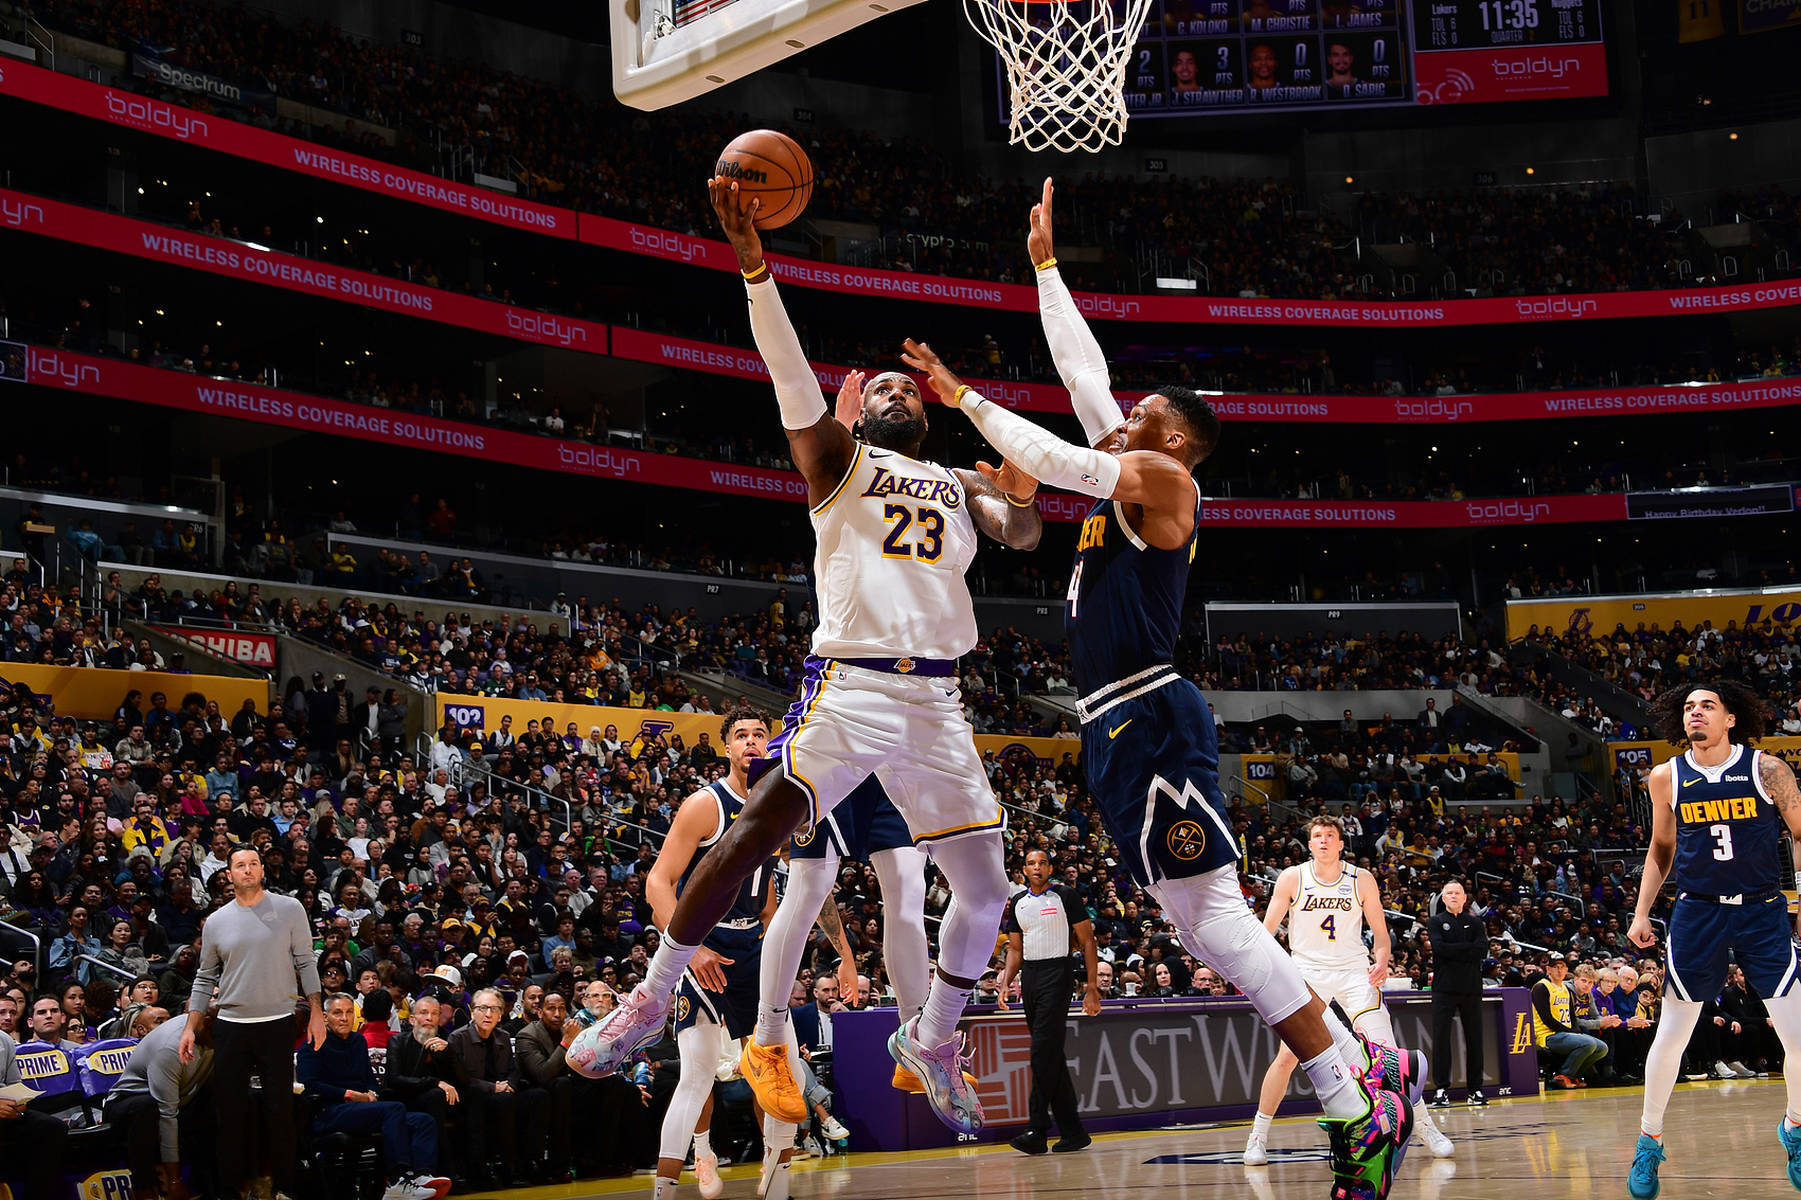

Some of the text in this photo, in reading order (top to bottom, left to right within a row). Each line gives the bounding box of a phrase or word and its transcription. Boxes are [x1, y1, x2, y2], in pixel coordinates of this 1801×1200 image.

[1265, 16, 1310, 32] CHRISTIE
[1347, 12, 1383, 28] JAMES
[1479, 0, 1539, 31] 11:35
[1139, 49, 1151, 74] 2
[1217, 46, 1229, 70] 3
[1295, 42, 1307, 66] 0
[1373, 38, 1386, 63] 0
[1215, 72, 1233, 85] PTS
[1293, 68, 1311, 82] PTS
[1371, 65, 1390, 78] PTS
[1491, 56, 1581, 79] boldyn
[160, 65, 241, 101] Spectrum
[1137, 75, 1155, 88] PTS
[1261, 85, 1322, 102] WESTBROOK
[1183, 90, 1244, 106] STRAWTHER
[105, 91, 208, 139] boldyn
[294, 149, 557, 229] WIRELESS COVERAGE SOLUTIONS
[629, 227, 706, 262] boldyn
[142, 232, 434, 311] WIRELESS COVERAGE SOLUTIONS
[770, 262, 1002, 303] WIRELESS COVERAGE SOLUTIONS
[1515, 297, 1598, 318] boldyn
[1669, 284, 1801, 310] WIRELESS COVE
[1208, 304, 1444, 322] WIRELESS COVERAGE SOLUTIONS
[505, 309, 587, 346] boldyn
[661, 343, 735, 369] WIRELESS
[1247, 402, 1328, 416] SOLUTIONS
[1395, 399, 1473, 420] boldyn
[1544, 386, 1801, 411] WIRELESS COVERAGE SOLUTIONS
[197, 386, 485, 451] WIRELESS COVERAGE SOLUTIONS
[557, 444, 641, 477] boldyn
[710, 470, 784, 491] WIRELESS
[860, 466, 961, 510] LAKERS
[1233, 508, 1311, 522] COVERAGE
[1313, 508, 1396, 522] SOLUTIONS
[1466, 500, 1549, 522] boldyn
[881, 503, 945, 565] 23
[1619, 750, 1648, 765] 105
[1250, 764, 1275, 777] 104
[1680, 797, 1758, 824] DENVER
[1710, 824, 1735, 862] 3
[1301, 894, 1353, 912] LAKERS
[1320, 915, 1337, 942] 4
[16, 1054, 61, 1076] PRIME
